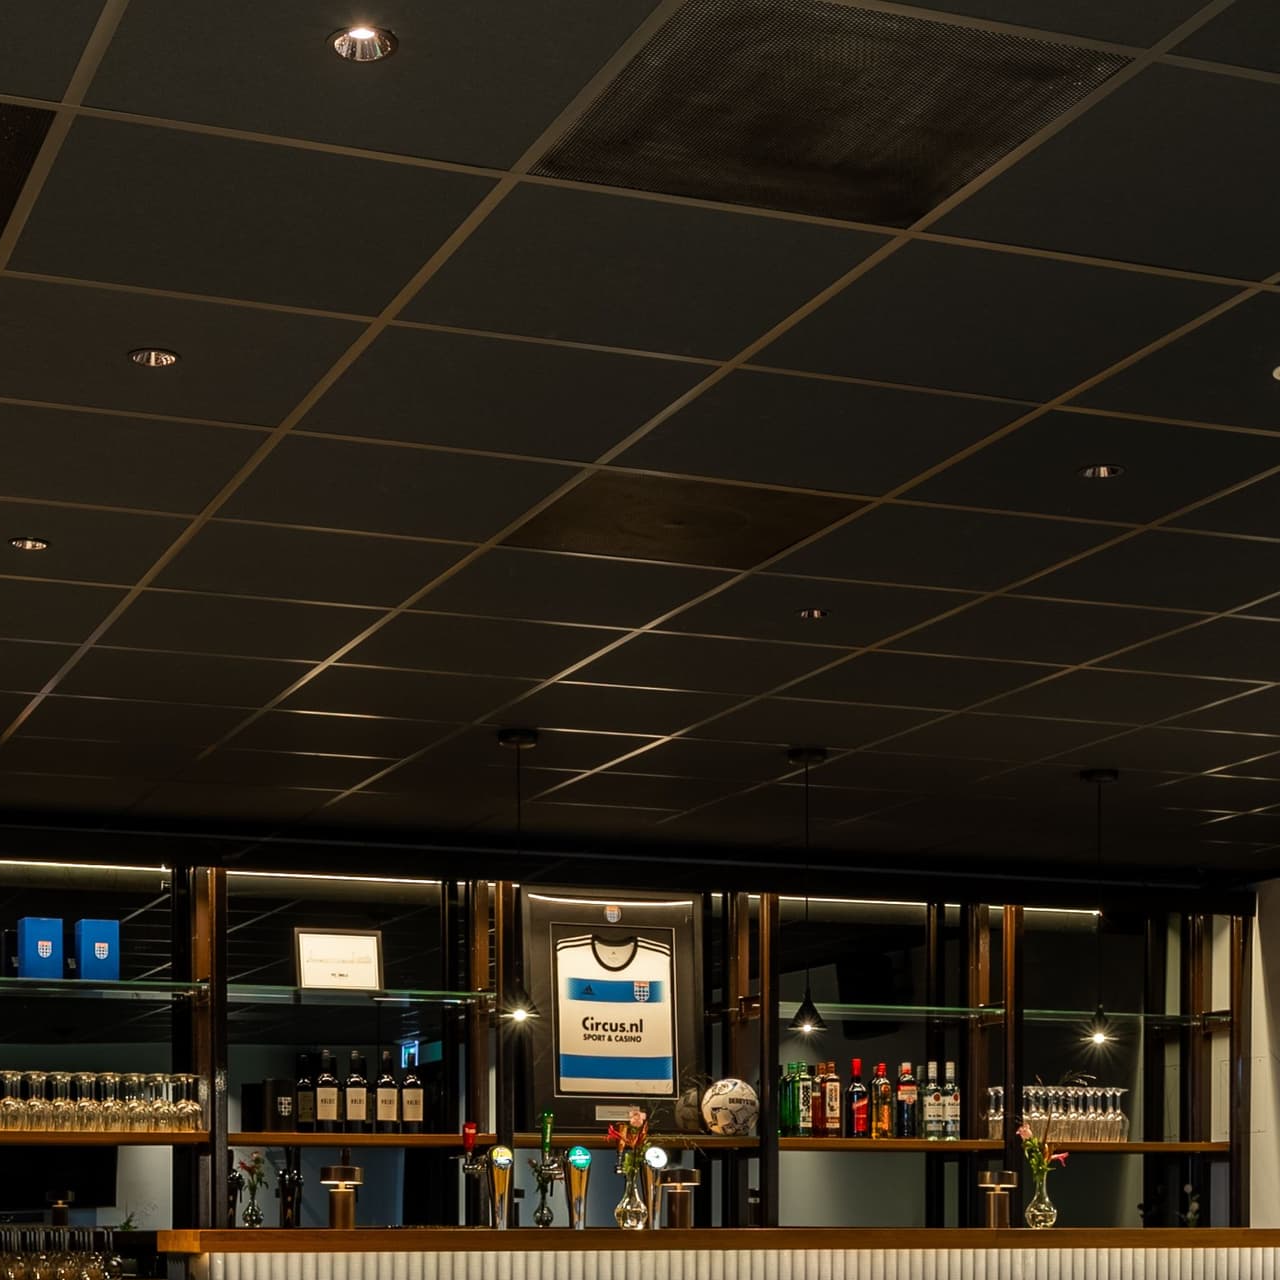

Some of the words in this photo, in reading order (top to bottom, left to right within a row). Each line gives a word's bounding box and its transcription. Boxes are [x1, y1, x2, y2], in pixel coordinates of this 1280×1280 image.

[582, 1016, 644, 1033] Circus.nl
[583, 1033, 606, 1042] SPORT
[607, 1034, 613, 1042] &
[614, 1034, 642, 1043] CASINO
